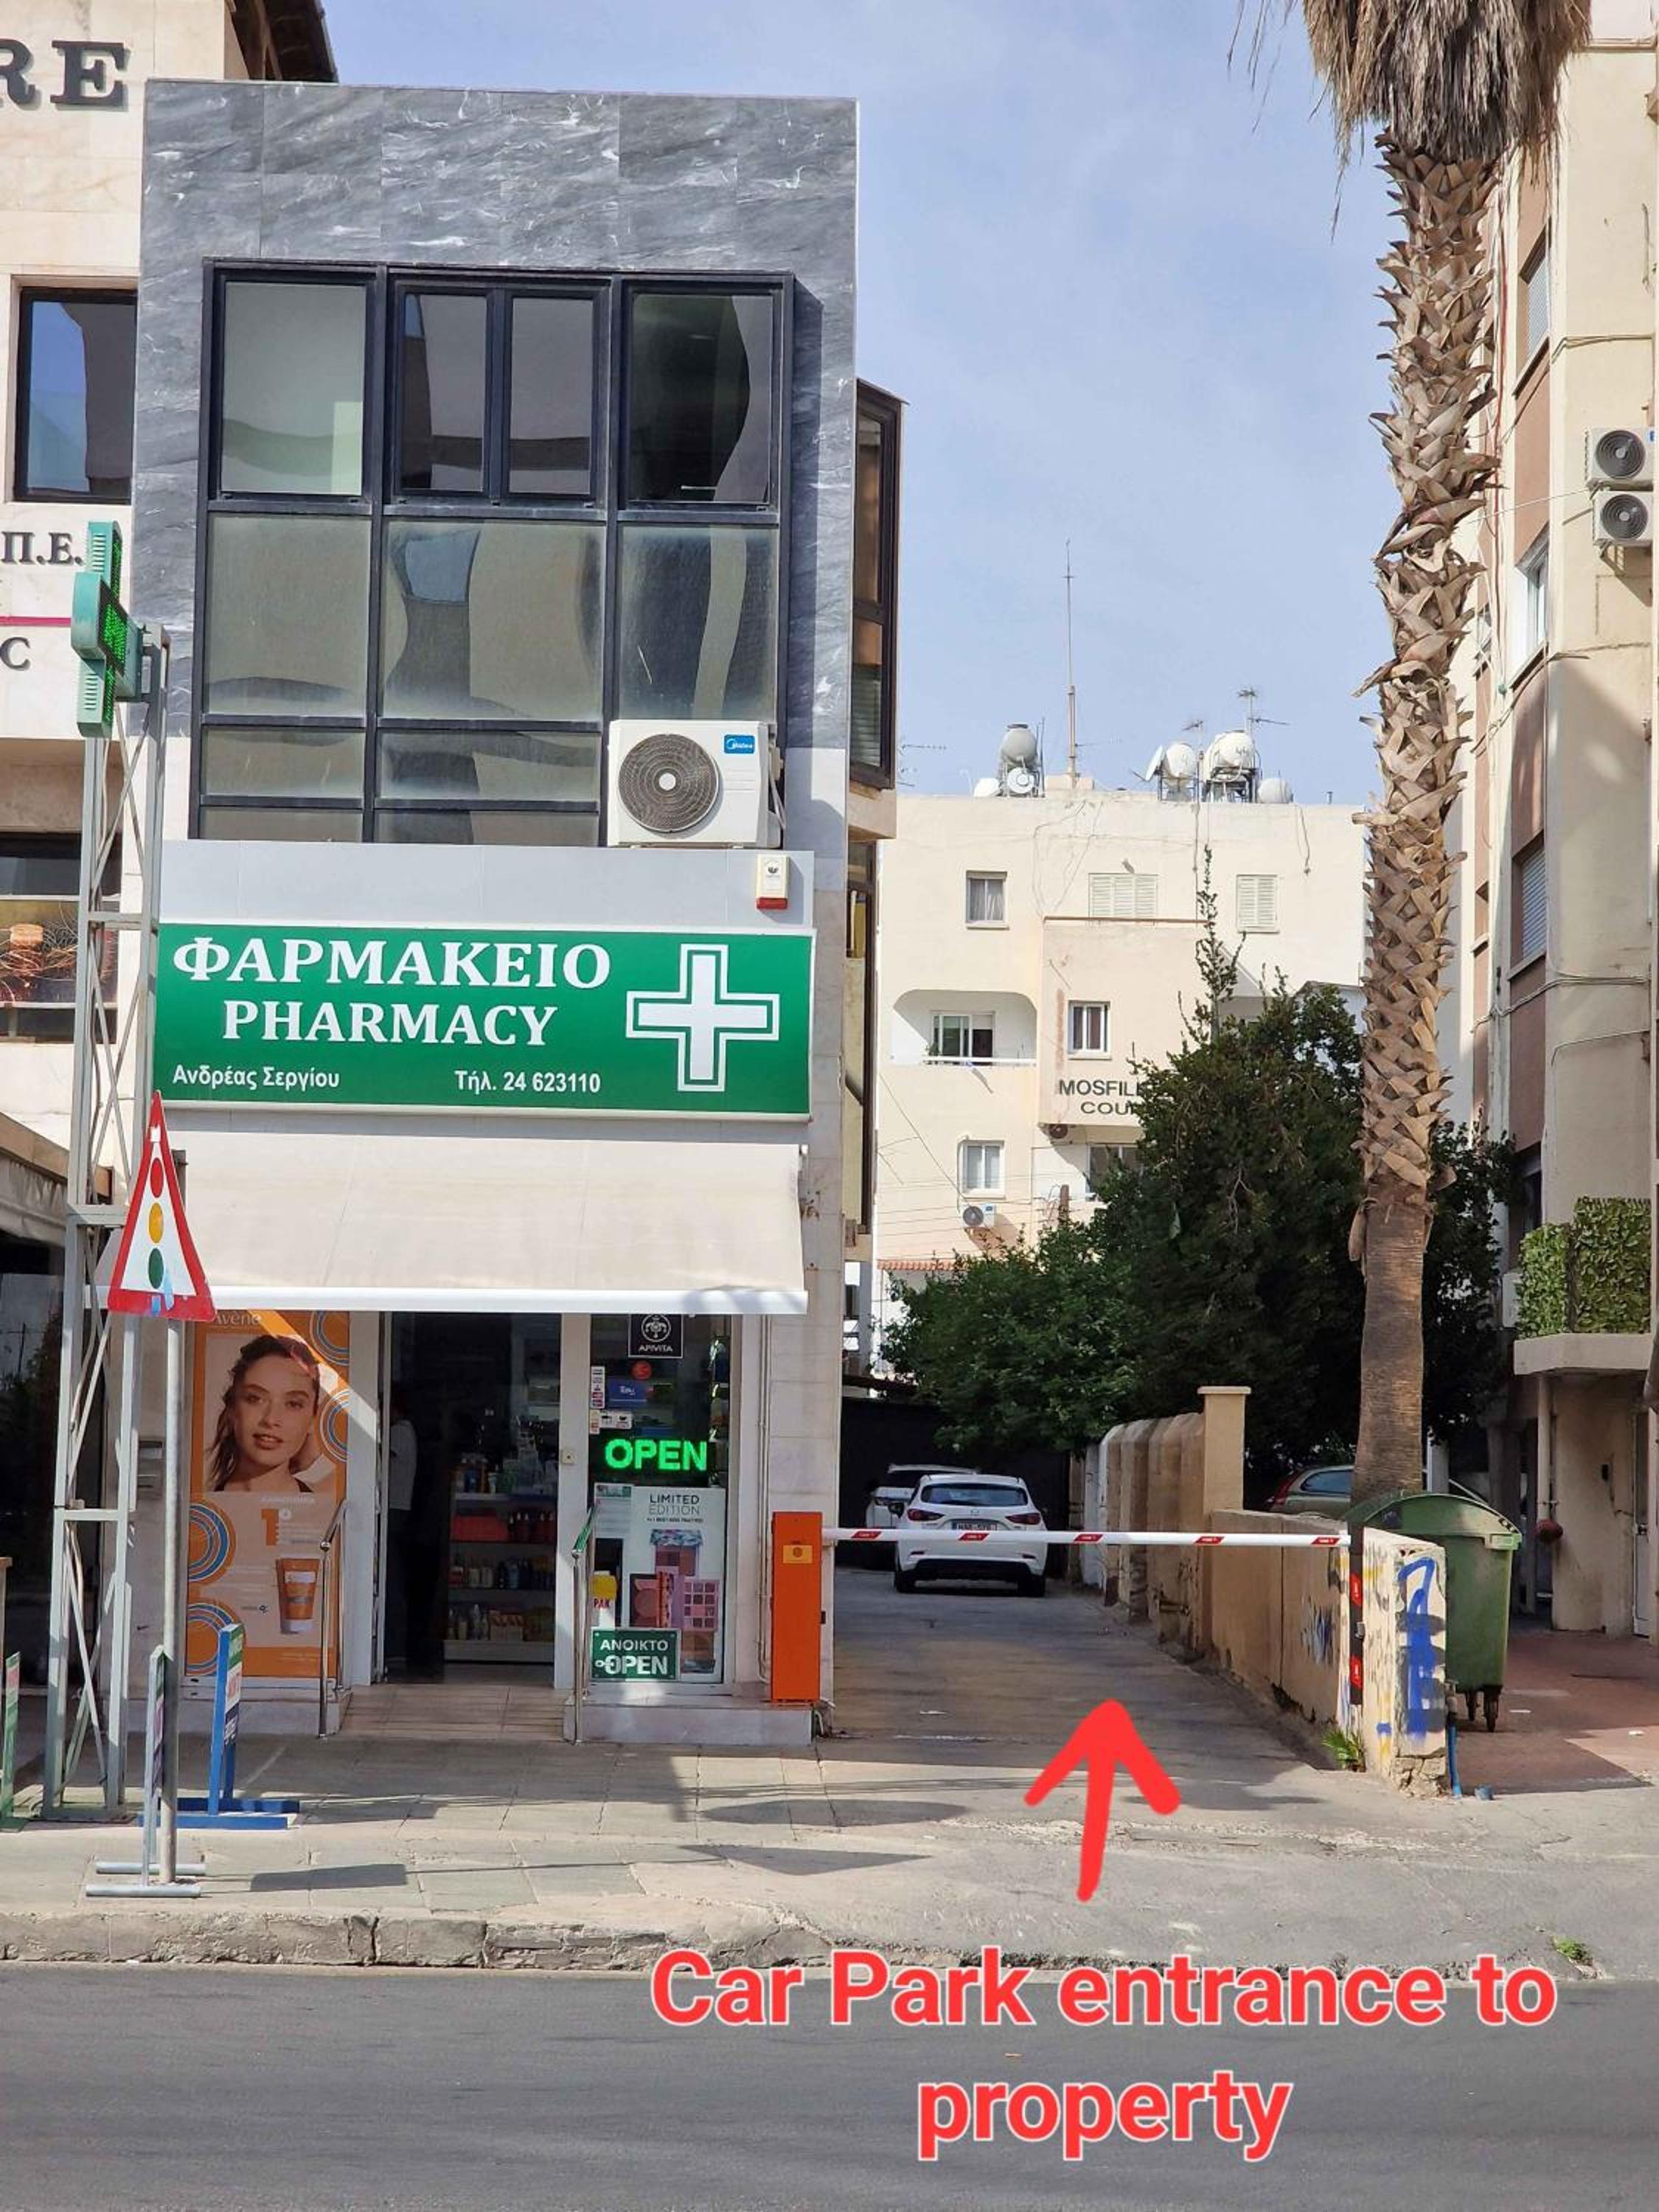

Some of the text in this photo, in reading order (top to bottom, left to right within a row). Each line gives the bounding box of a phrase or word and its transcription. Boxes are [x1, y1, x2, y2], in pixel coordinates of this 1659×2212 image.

[173, 937, 611, 989] ΦΑΡΜΑΚΕΙΟ
[223, 1000, 558, 1046] PHARMACY
[173, 1064, 340, 1091] Ανδρέας Σεργίου
[454, 1070, 601, 1095] Τήλ. 24 623110
[1080, 1102, 1134, 1115] COU
[605, 1438, 707, 1471] OPEN
[649, 1504, 700, 1515] EDITION
[650, 1493, 700, 1504] LIMITED
[600, 1639, 668, 1651] ΑΝΟΙΚΤΟ
[604, 1655, 668, 1674] OPEN
